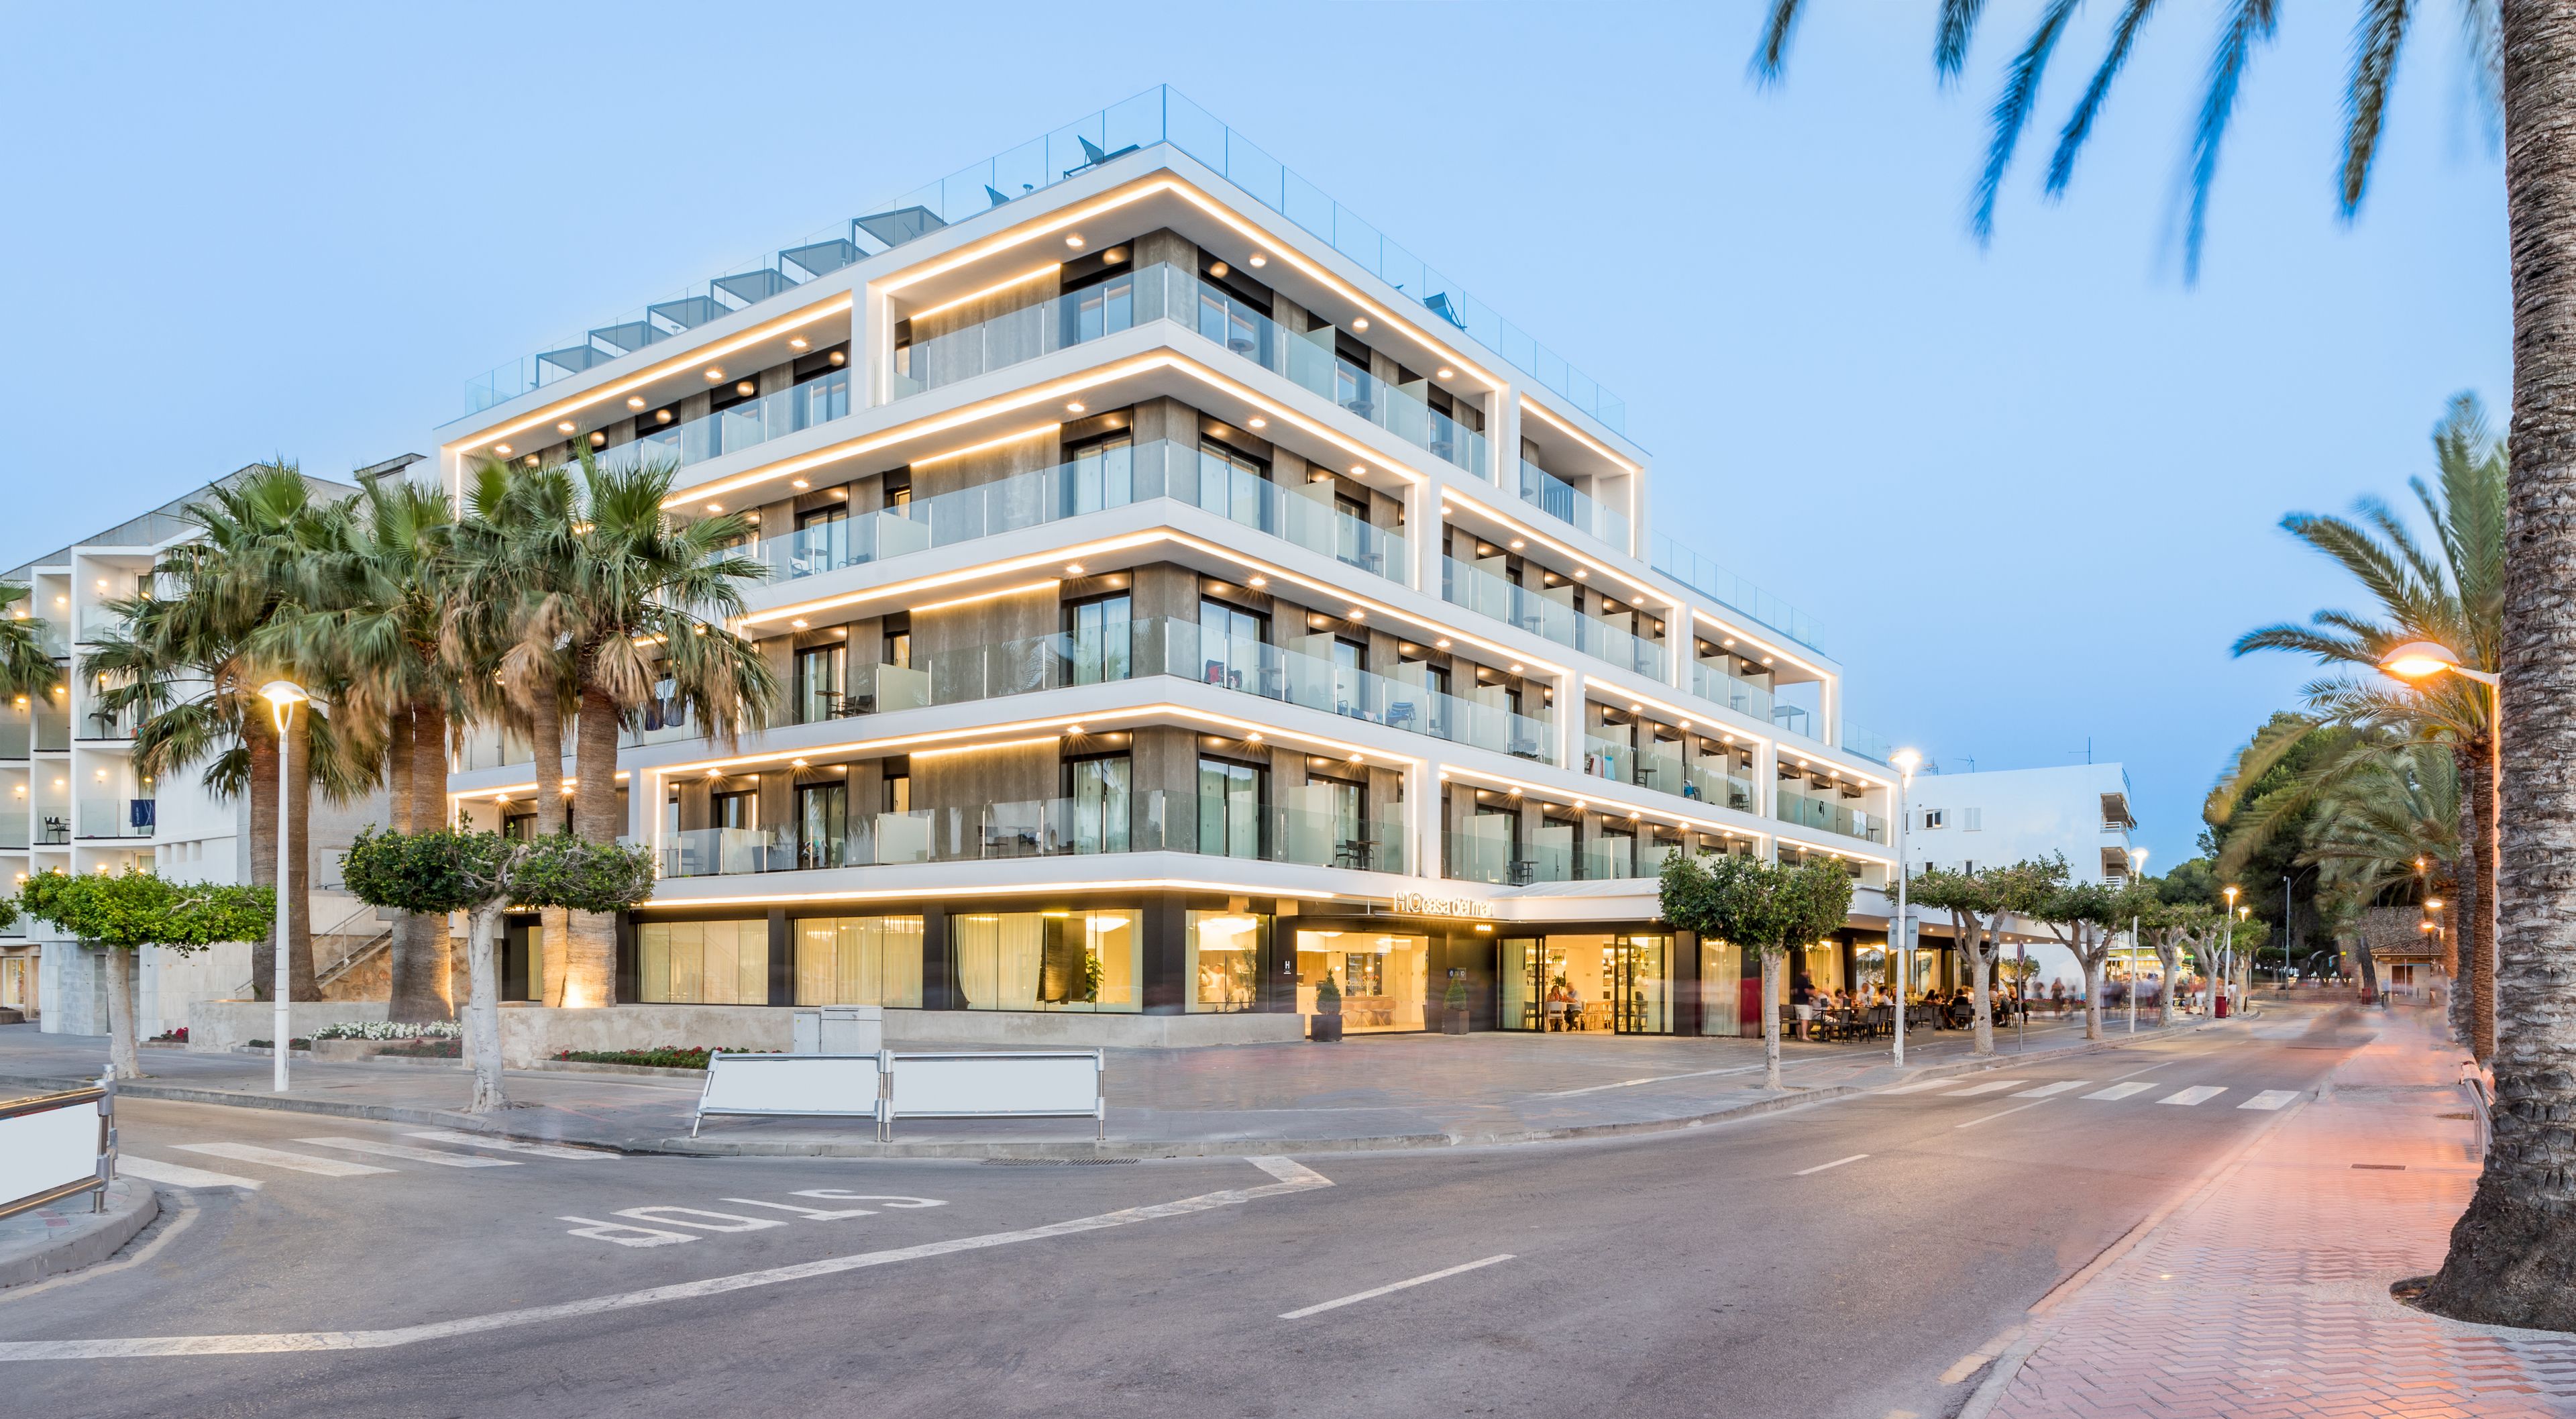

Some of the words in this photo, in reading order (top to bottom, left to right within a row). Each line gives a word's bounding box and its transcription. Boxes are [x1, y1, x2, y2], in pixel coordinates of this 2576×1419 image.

[1421, 897, 1450, 915] casa
[1452, 897, 1470, 916] del
[1471, 900, 1494, 918] mar
[554, 1189, 950, 1249] STOP
